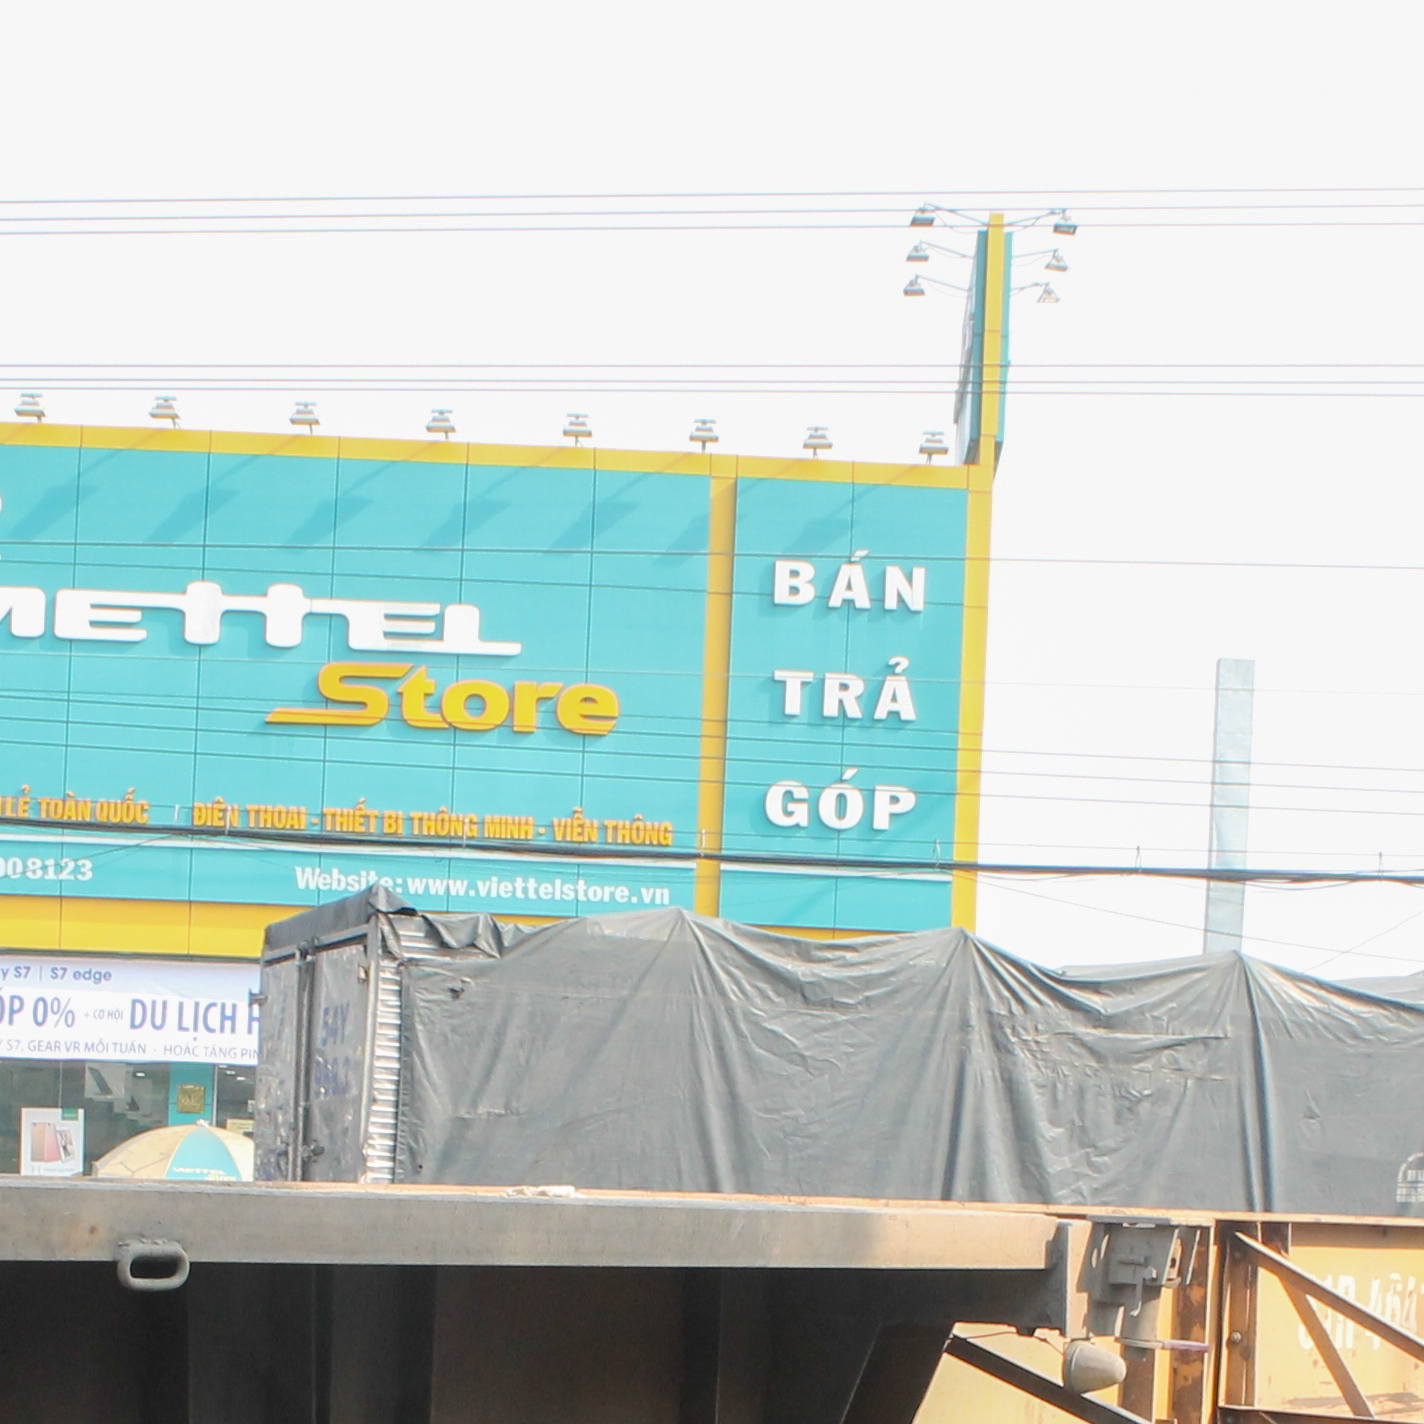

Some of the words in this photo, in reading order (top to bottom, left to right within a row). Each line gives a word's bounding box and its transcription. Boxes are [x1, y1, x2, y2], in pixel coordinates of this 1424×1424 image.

[773, 549, 926, 612] BÁN
[264, 661, 621, 736] Store
[773, 656, 917, 722] TRẢ
[38, 790, 93, 823] TOÀN
[95, 787, 150, 825] QUỐC
[410, 806, 478, 838] THÔNG
[483, 815, 534, 841] MINH
[604, 813, 673, 847] THÔNG
[765, 767, 917, 831] GÓP
[13, 966, 31, 979] S7
[50, 967, 68, 980] S7
[73, 968, 113, 985] edge
[27, 1040, 62, 1053] GEAR
[64, 1041, 81, 1053] VR
[32, 997, 76, 1028] 0%
[130, 998, 168, 1031] DU
[177, 1001, 237, 1041] LỊCH
